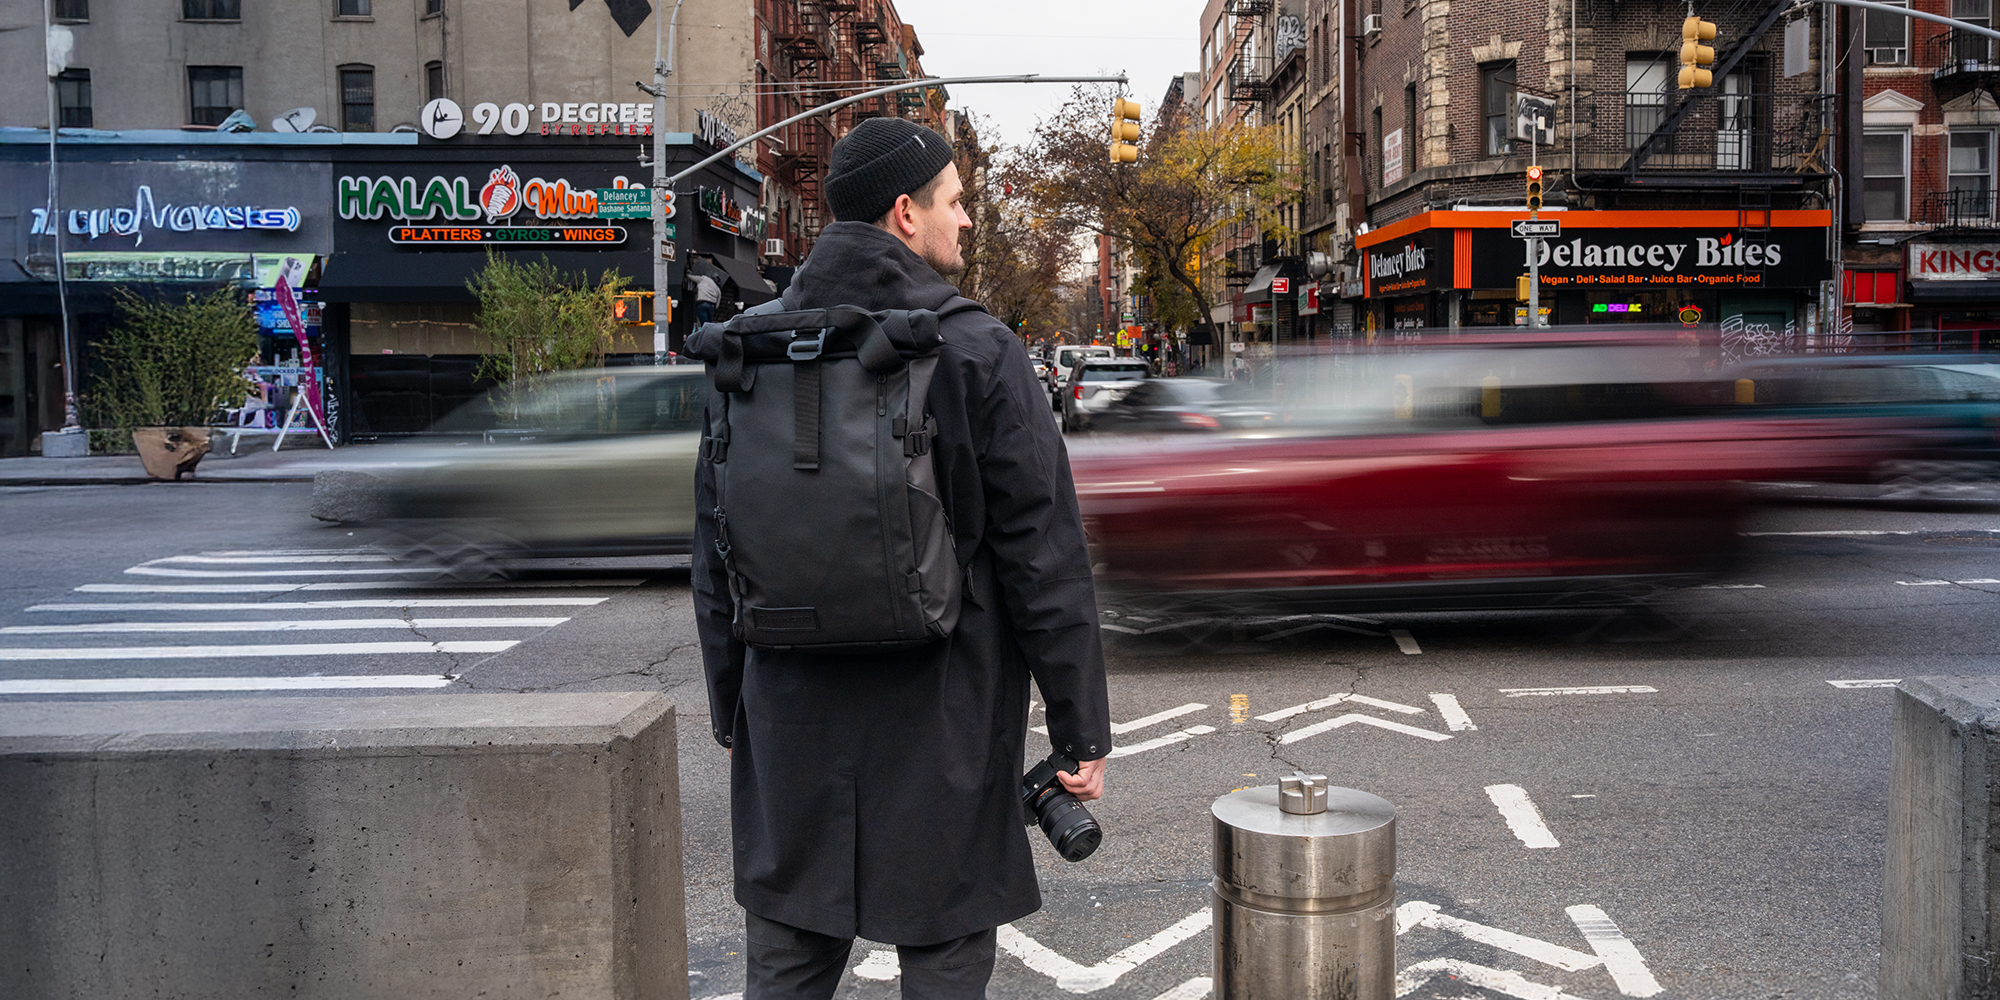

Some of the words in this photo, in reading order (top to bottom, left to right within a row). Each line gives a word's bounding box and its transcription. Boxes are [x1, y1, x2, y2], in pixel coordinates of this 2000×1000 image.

[541, 102, 654, 123] DEGREE
[540, 124, 563, 136] BY
[571, 124, 653, 136] REFLEX
[340, 177, 479, 218] HALAL
[603, 190, 638, 203] Delancey
[626, 204, 651, 212] Santana
[401, 228, 482, 241] PLATTERS
[495, 228, 550, 241] GYROS
[563, 228, 615, 241] WINGS
[1523, 238, 1688, 271] Delancey
[1696, 236, 1782, 267] Bites
[1371, 253, 1404, 279] Delancey
[1405, 243, 1425, 272] Bites
[1920, 250, 2000, 273] KING
[1540, 275, 1569, 286] Vegan
[1576, 274, 1594, 284] Deli
[1599, 274, 1625, 284] Salad
[1627, 274, 1644, 284] Bar
[1649, 274, 1674, 284] Juice
[1676, 274, 1693, 284] Bar
[1698, 274, 1734, 285] Organic
[1736, 273, 1760, 283] Food
[307, 308, 321, 317] ATM
